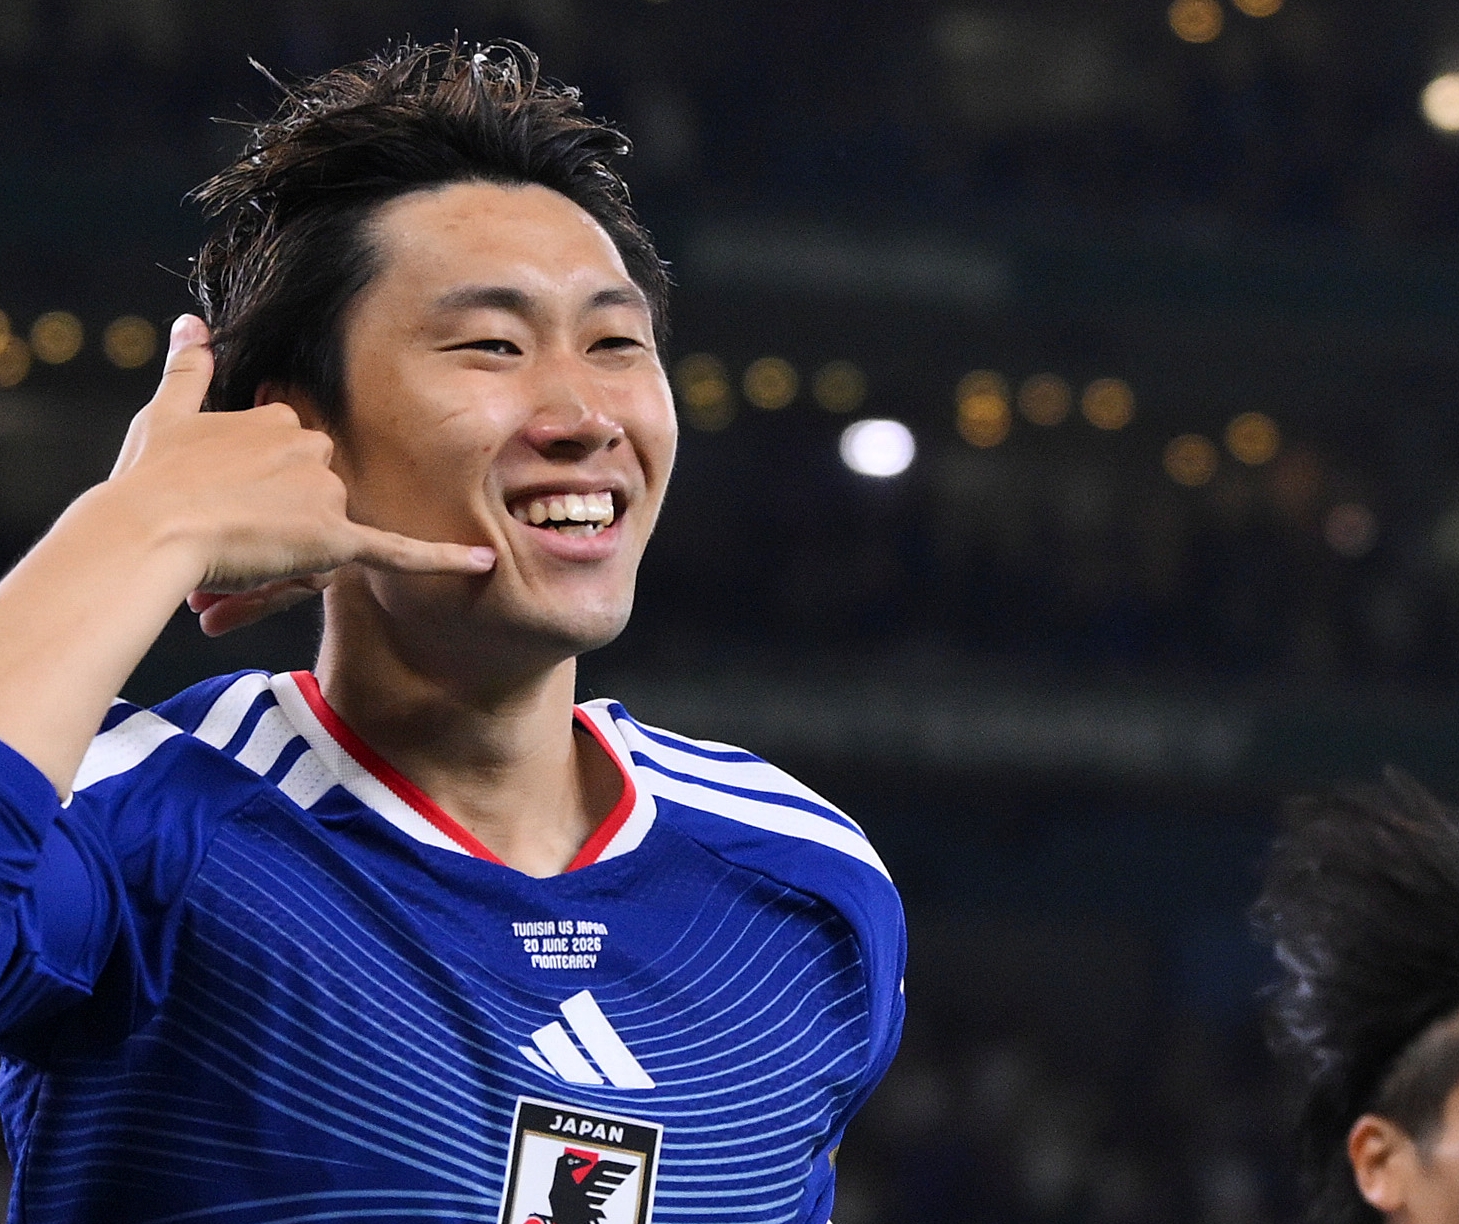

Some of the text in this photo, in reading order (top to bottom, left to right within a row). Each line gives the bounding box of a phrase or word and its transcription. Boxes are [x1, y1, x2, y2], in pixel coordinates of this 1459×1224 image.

[511, 921, 555, 937] TUNISIA
[576, 920, 609, 935] JAPAN
[523, 937, 602, 953] 20 JUNE 2026
[531, 954, 597, 969] MONTERREY
[549, 1114, 624, 1143] JAPAN
